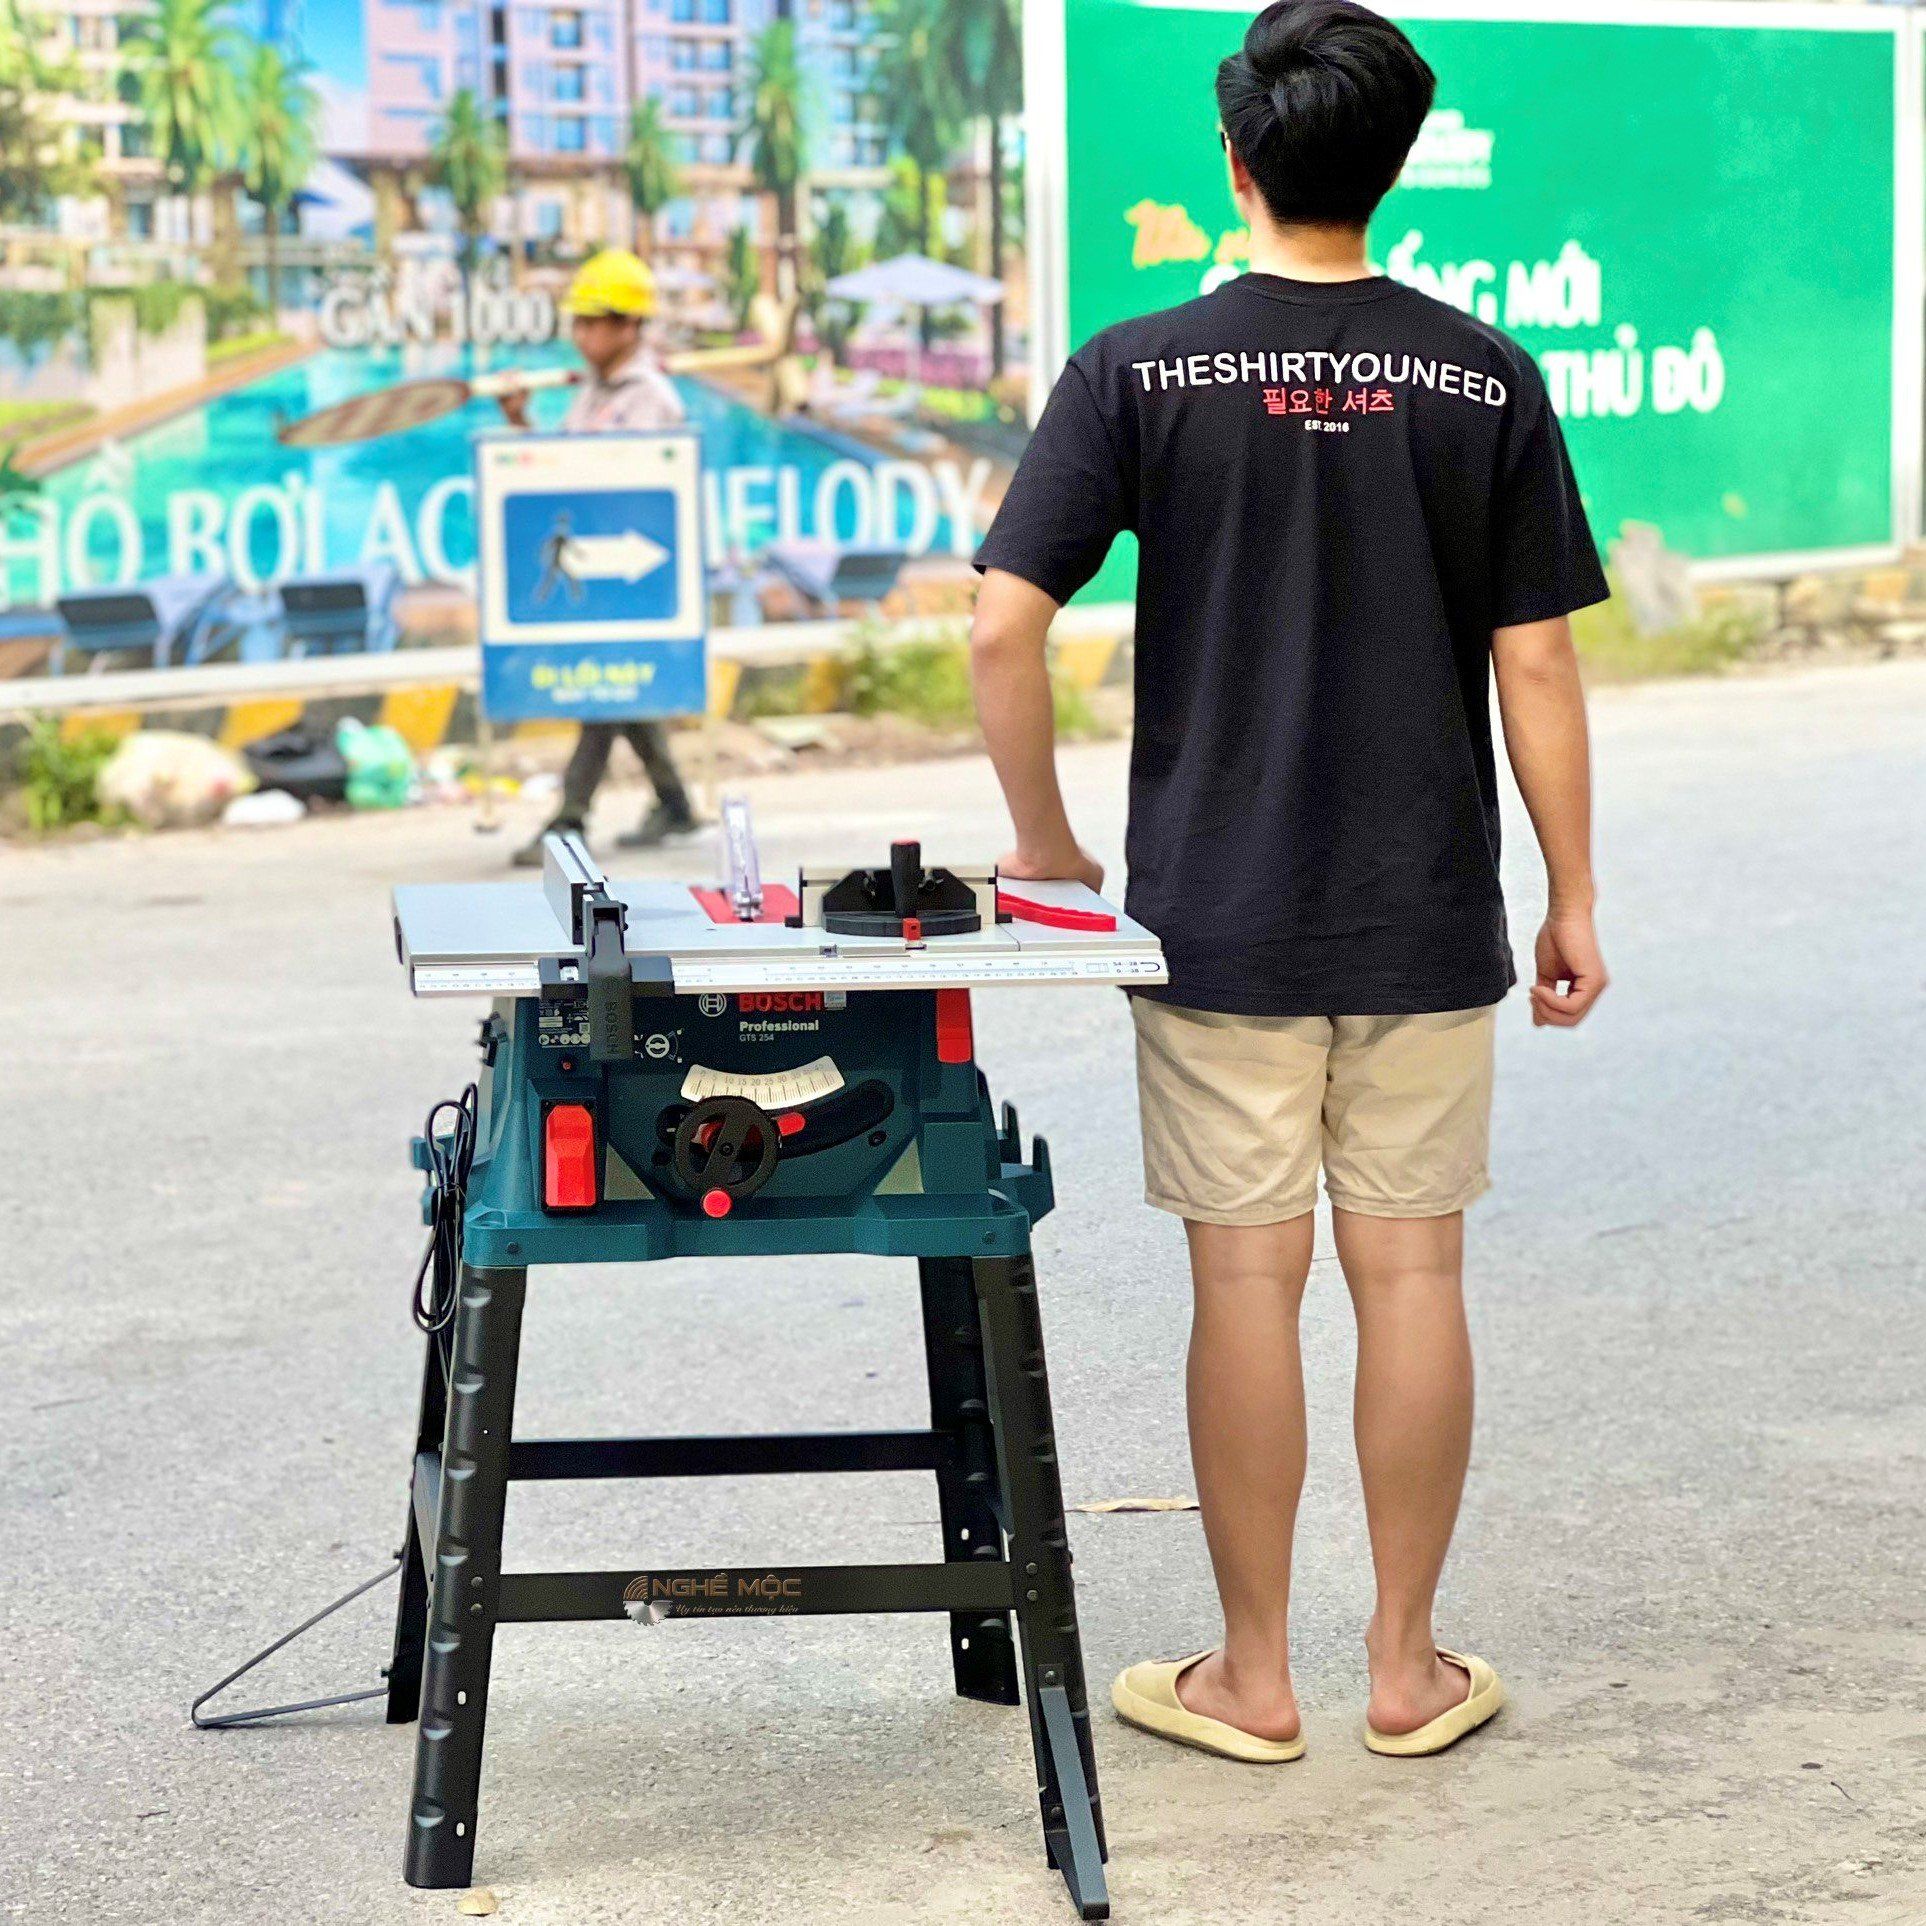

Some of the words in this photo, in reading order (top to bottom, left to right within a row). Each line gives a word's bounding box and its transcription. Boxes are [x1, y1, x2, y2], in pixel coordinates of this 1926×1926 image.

[1132, 351, 1507, 407] THESHIRTYOUNEED
[1262, 387, 1333, 415] 필요한
[1341, 387, 1395, 415] 셔츠
[703, 455, 993, 567] ELODY
[739, 992, 822, 1012] BOSCH
[739, 1020, 819, 1032] Professional
[739, 1034, 756, 1042] GTS
[759, 1034, 774, 1042] 254
